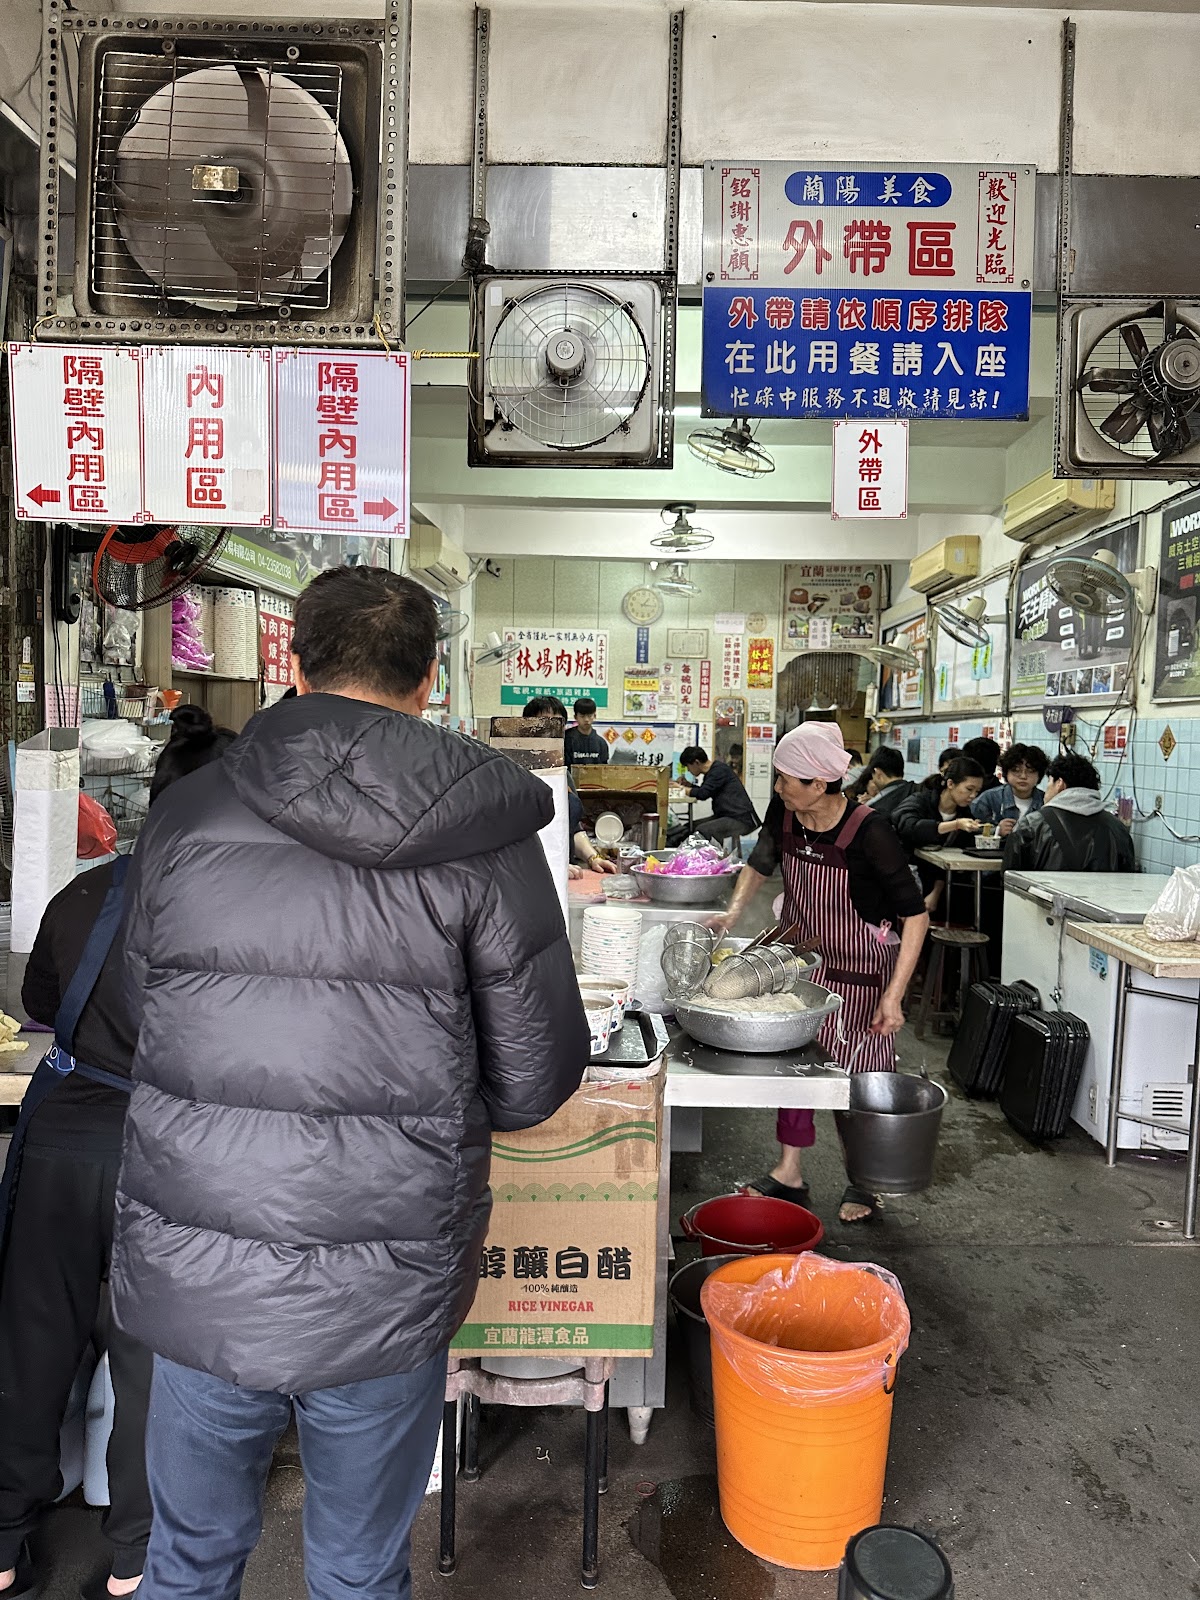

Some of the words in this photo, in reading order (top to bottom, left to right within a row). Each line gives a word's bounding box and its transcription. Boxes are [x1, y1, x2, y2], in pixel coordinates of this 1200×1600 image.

[728, 177, 753, 272] 銘謝惠顧
[782, 219, 957, 277] 外帶區
[985, 178, 1011, 276] 歡迎光臨
[727, 296, 1009, 332] 外帶請依順序排隊
[724, 340, 1007, 378] 在此用餐請入座
[62, 355, 108, 513] 隔壁內用區
[185, 365, 227, 510] 內用區
[317, 362, 359, 523] 隔壁內用區
[858, 429, 883, 511] 外帶區
[508, 1300, 537, 1312] RICE
[540, 1300, 594, 1312] VINEGAR
[523, 1284, 549, 1293] 100%
[484, 1327, 589, 1345] 宜蘭龍潭食品
